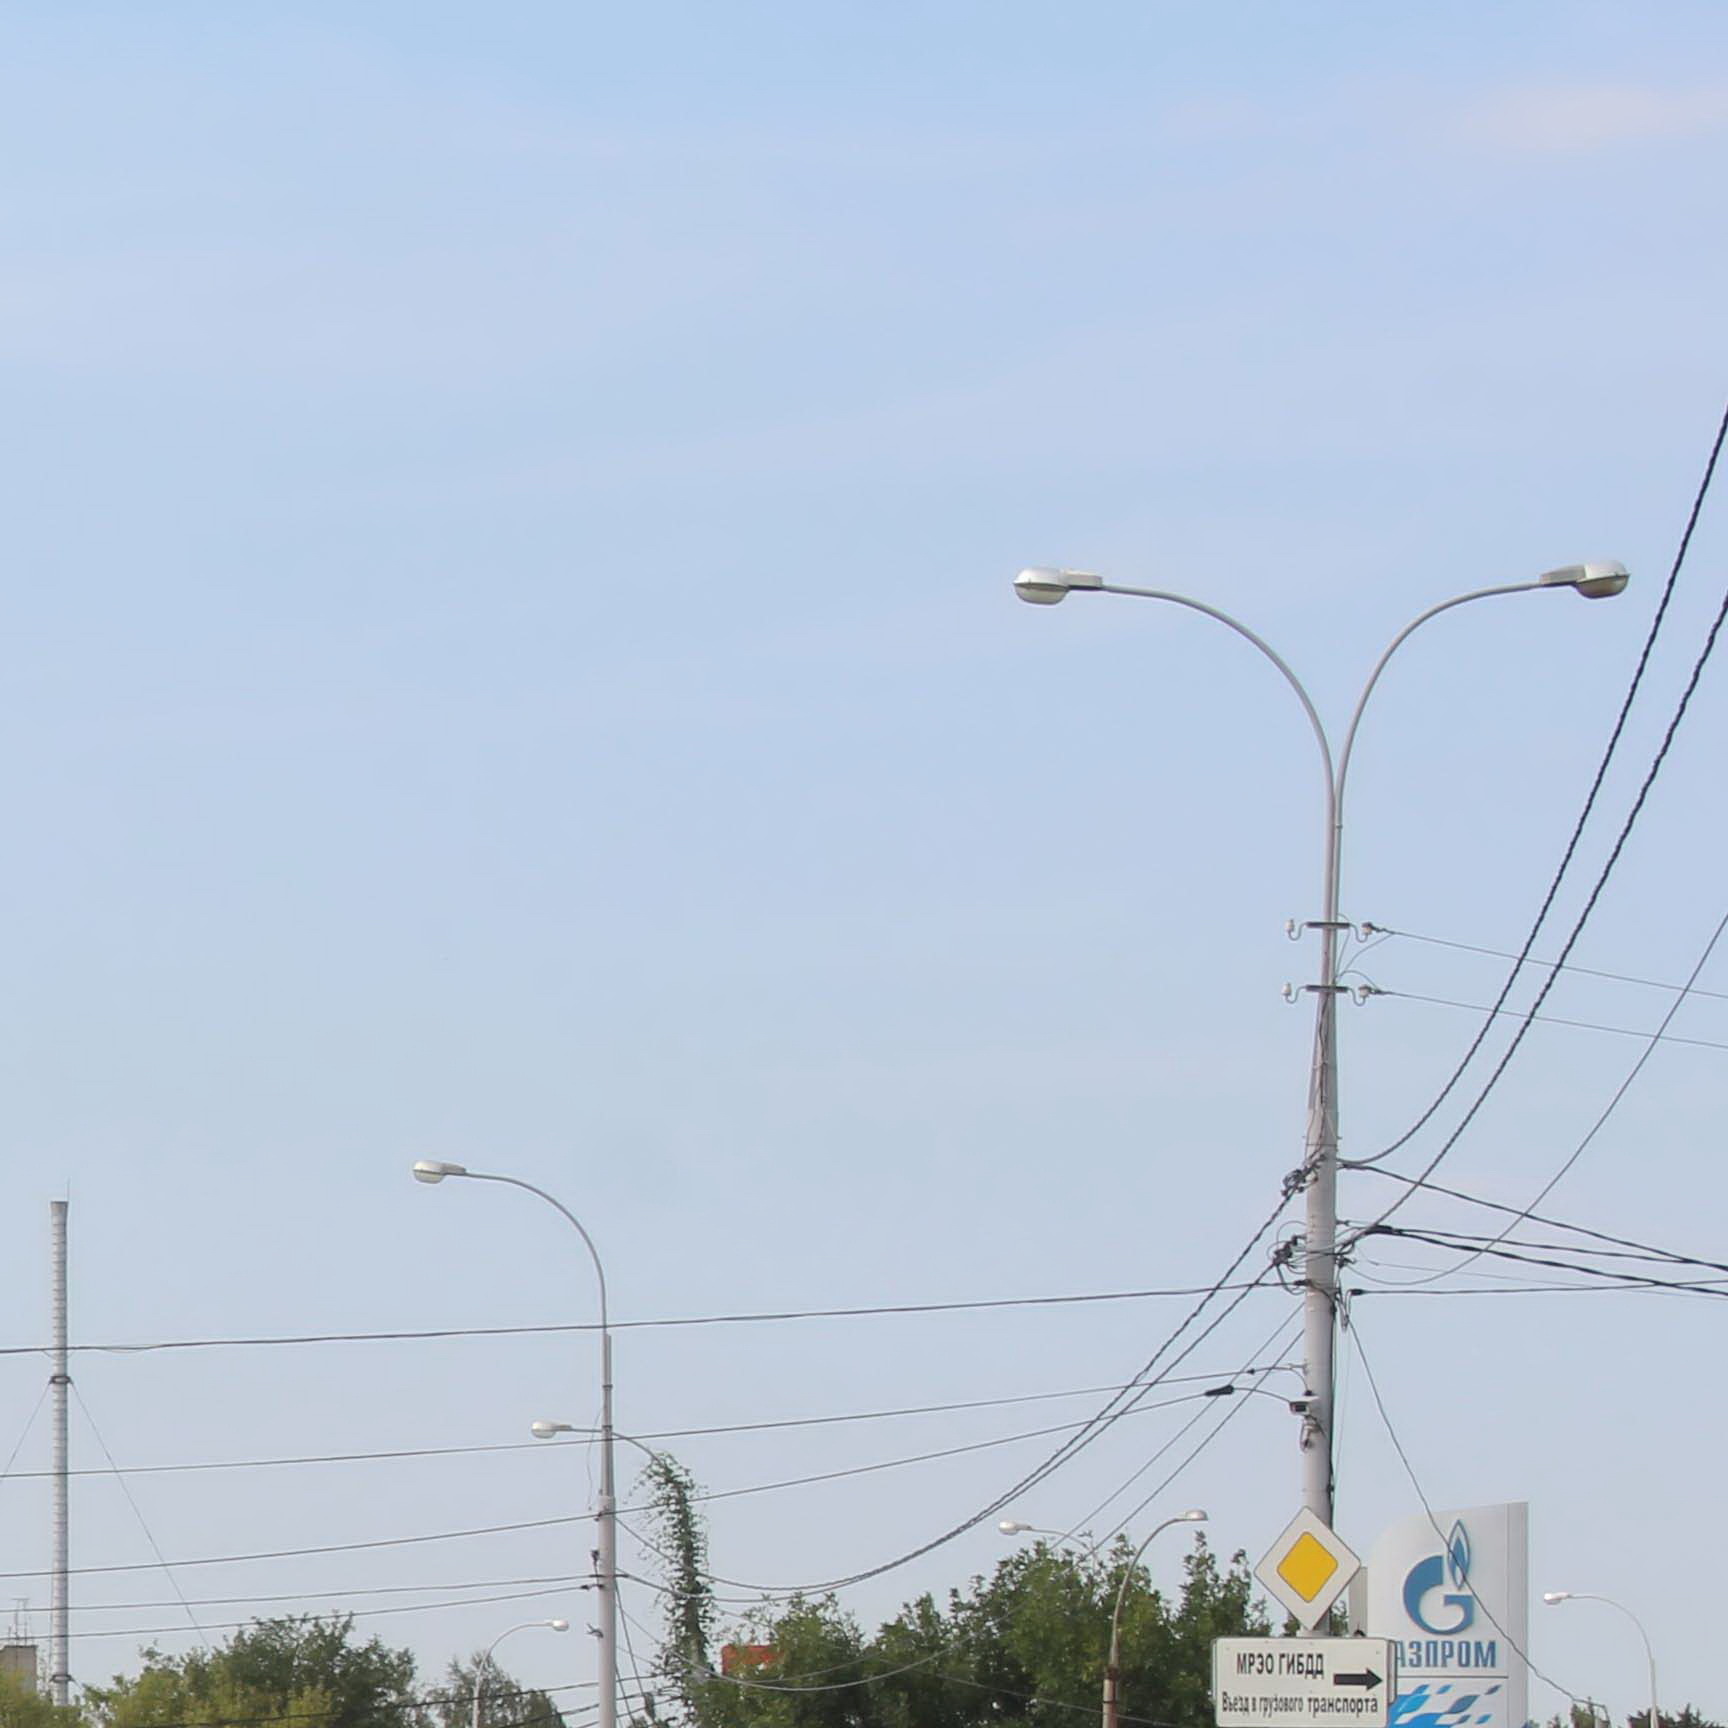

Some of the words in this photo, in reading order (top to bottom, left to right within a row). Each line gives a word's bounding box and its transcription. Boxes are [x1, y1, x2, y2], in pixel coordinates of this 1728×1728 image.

[1236, 1652, 1274, 1676] МРЭО
[1278, 1652, 1325, 1679] ГИБДД
[1396, 1640, 1497, 1669] АЗПРОМ
[1221, 1690, 1250, 1715] Въезд
[1251, 1697, 1257, 1712] в
[1259, 1695, 1304, 1718] грузового
[1307, 1695, 1378, 1719] транспорта
